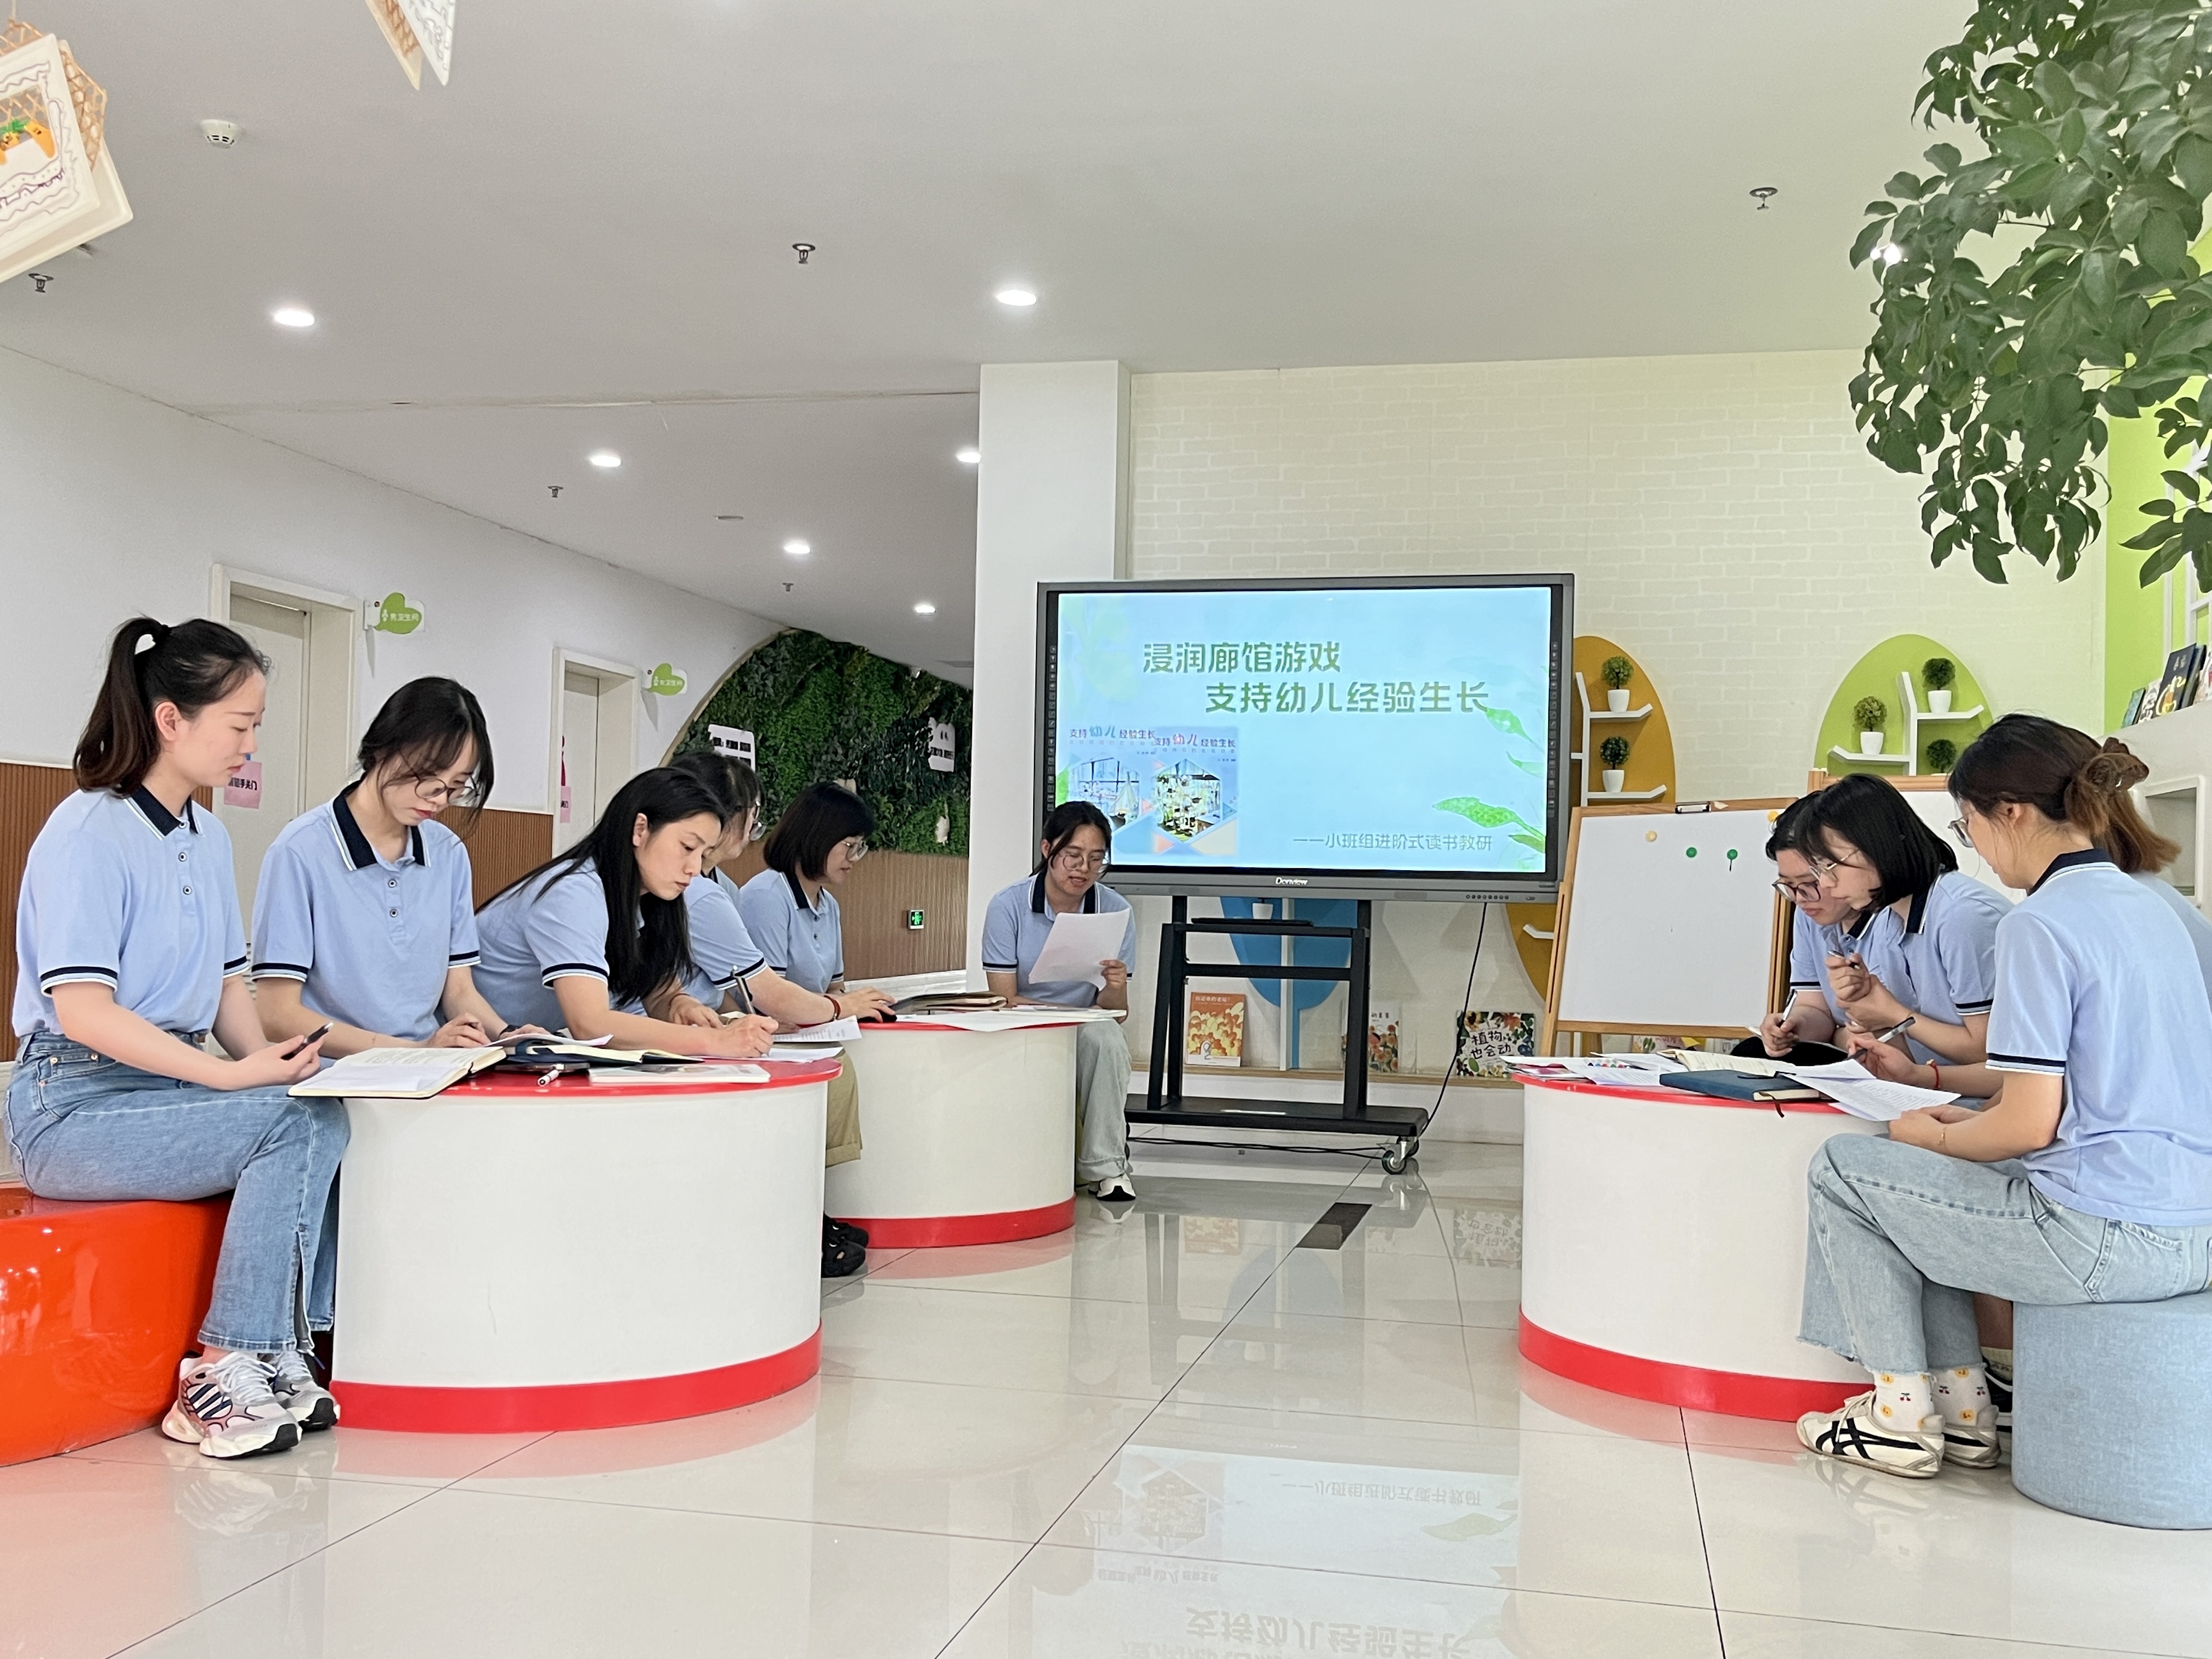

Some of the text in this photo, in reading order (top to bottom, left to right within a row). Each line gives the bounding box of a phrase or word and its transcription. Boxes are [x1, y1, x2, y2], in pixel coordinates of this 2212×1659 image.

[1143, 641, 1340, 673] 浸润廊馆游戏
[1205, 681, 1488, 713] 支持幼儿经验生长
[1471, 1031, 1502, 1045] 植物
[1471, 1043, 1511, 1059] 也会动
